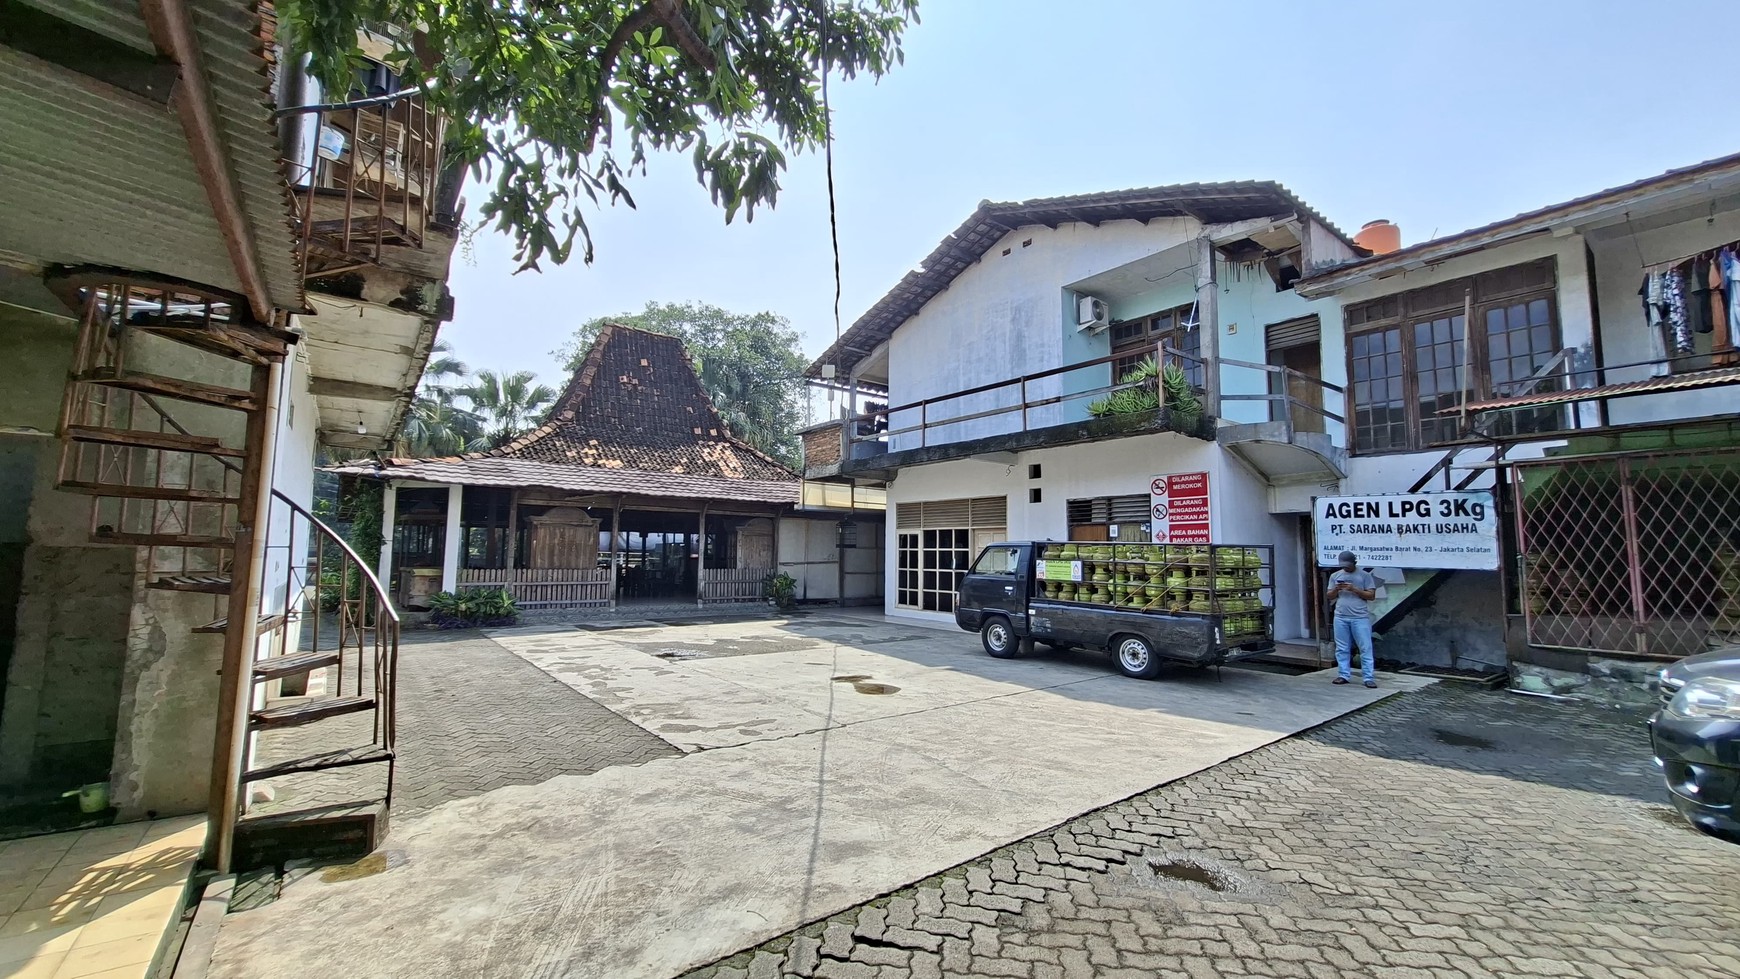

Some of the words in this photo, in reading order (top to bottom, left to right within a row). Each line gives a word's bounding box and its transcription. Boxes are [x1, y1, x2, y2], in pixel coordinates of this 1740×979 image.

[1325, 502, 1380, 519] AGEN
[1388, 500, 1431, 518] LPG
[1439, 498, 1485, 521] 3Kg
[1331, 524, 1345, 534] PT.
[1349, 523, 1393, 534] SARANA
[1397, 523, 1431, 534] BAKTI
[1435, 523, 1478, 534] USAHA
[1359, 545, 1393, 553] Margasatwa
